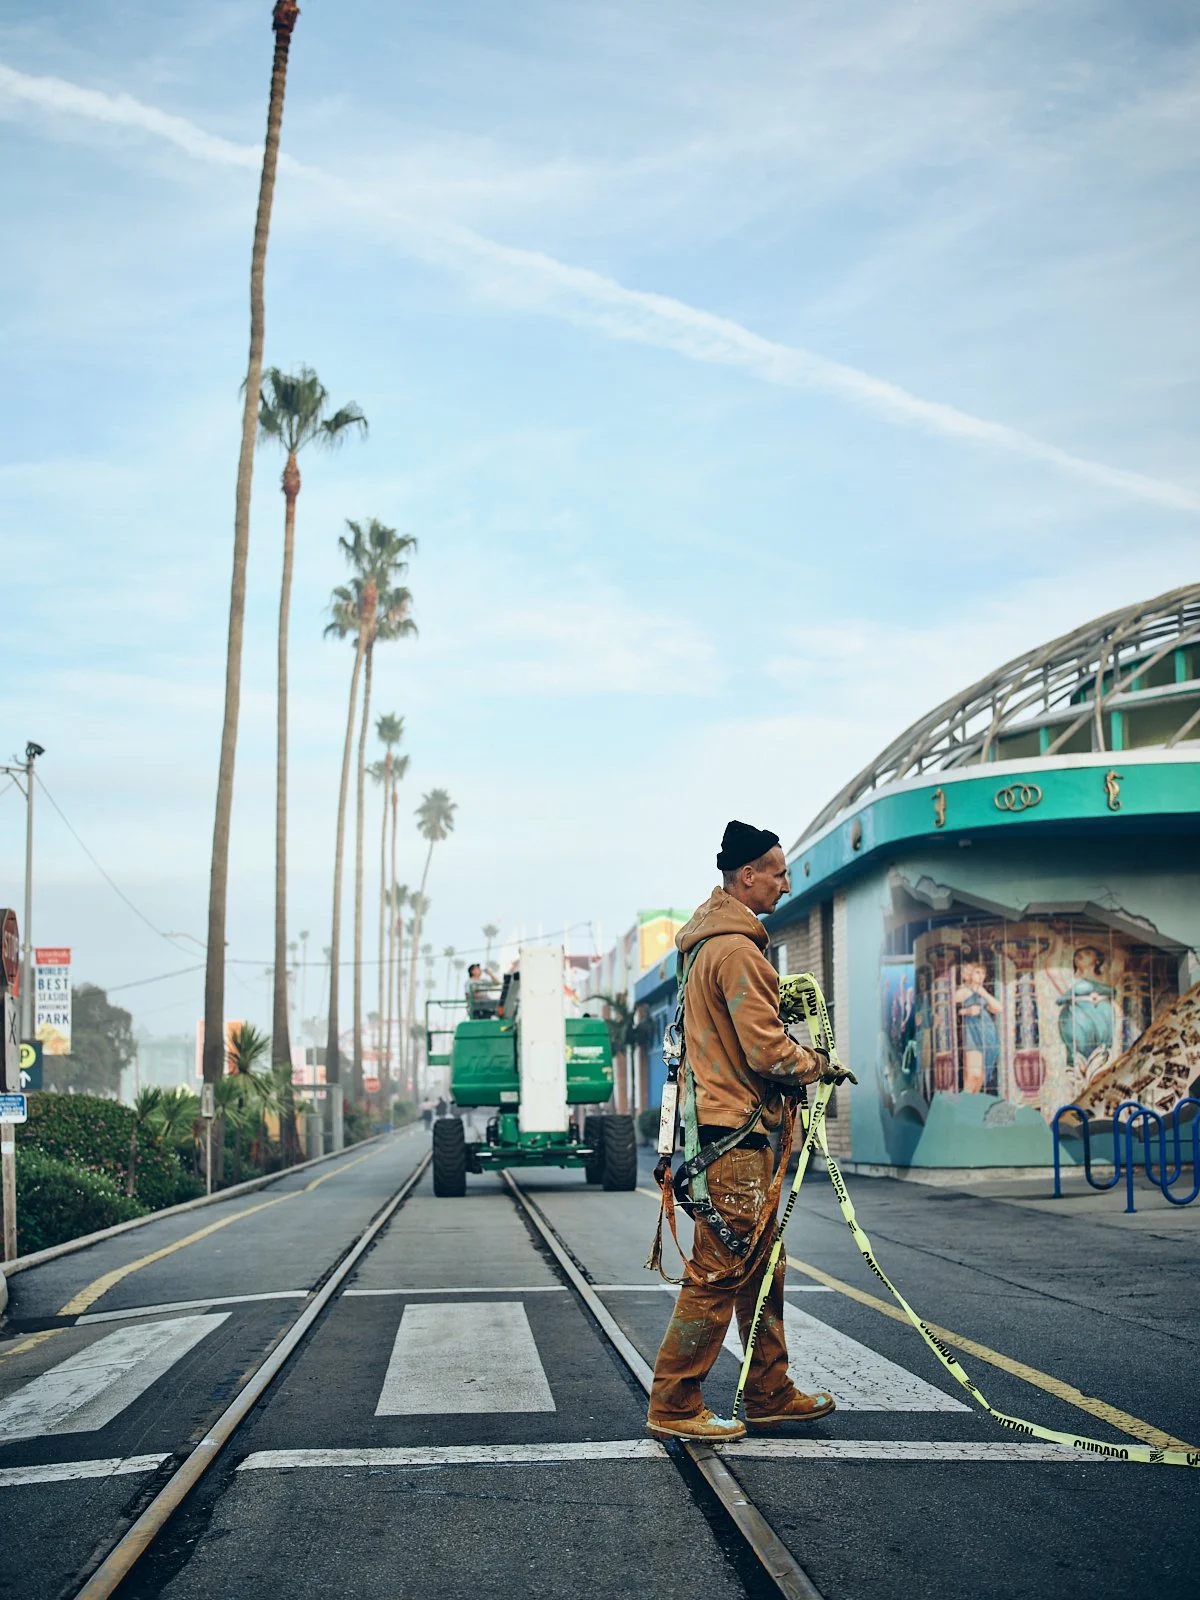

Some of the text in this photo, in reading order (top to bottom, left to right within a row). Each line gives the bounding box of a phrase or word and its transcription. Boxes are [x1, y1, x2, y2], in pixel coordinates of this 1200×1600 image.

[5, 929, 19, 958] STOP
[37, 978, 68, 990] BEST
[37, 1013, 69, 1024] PARK
[20, 1047, 30, 1063] P
[1073, 1439, 1129, 1460] CUIDADO
